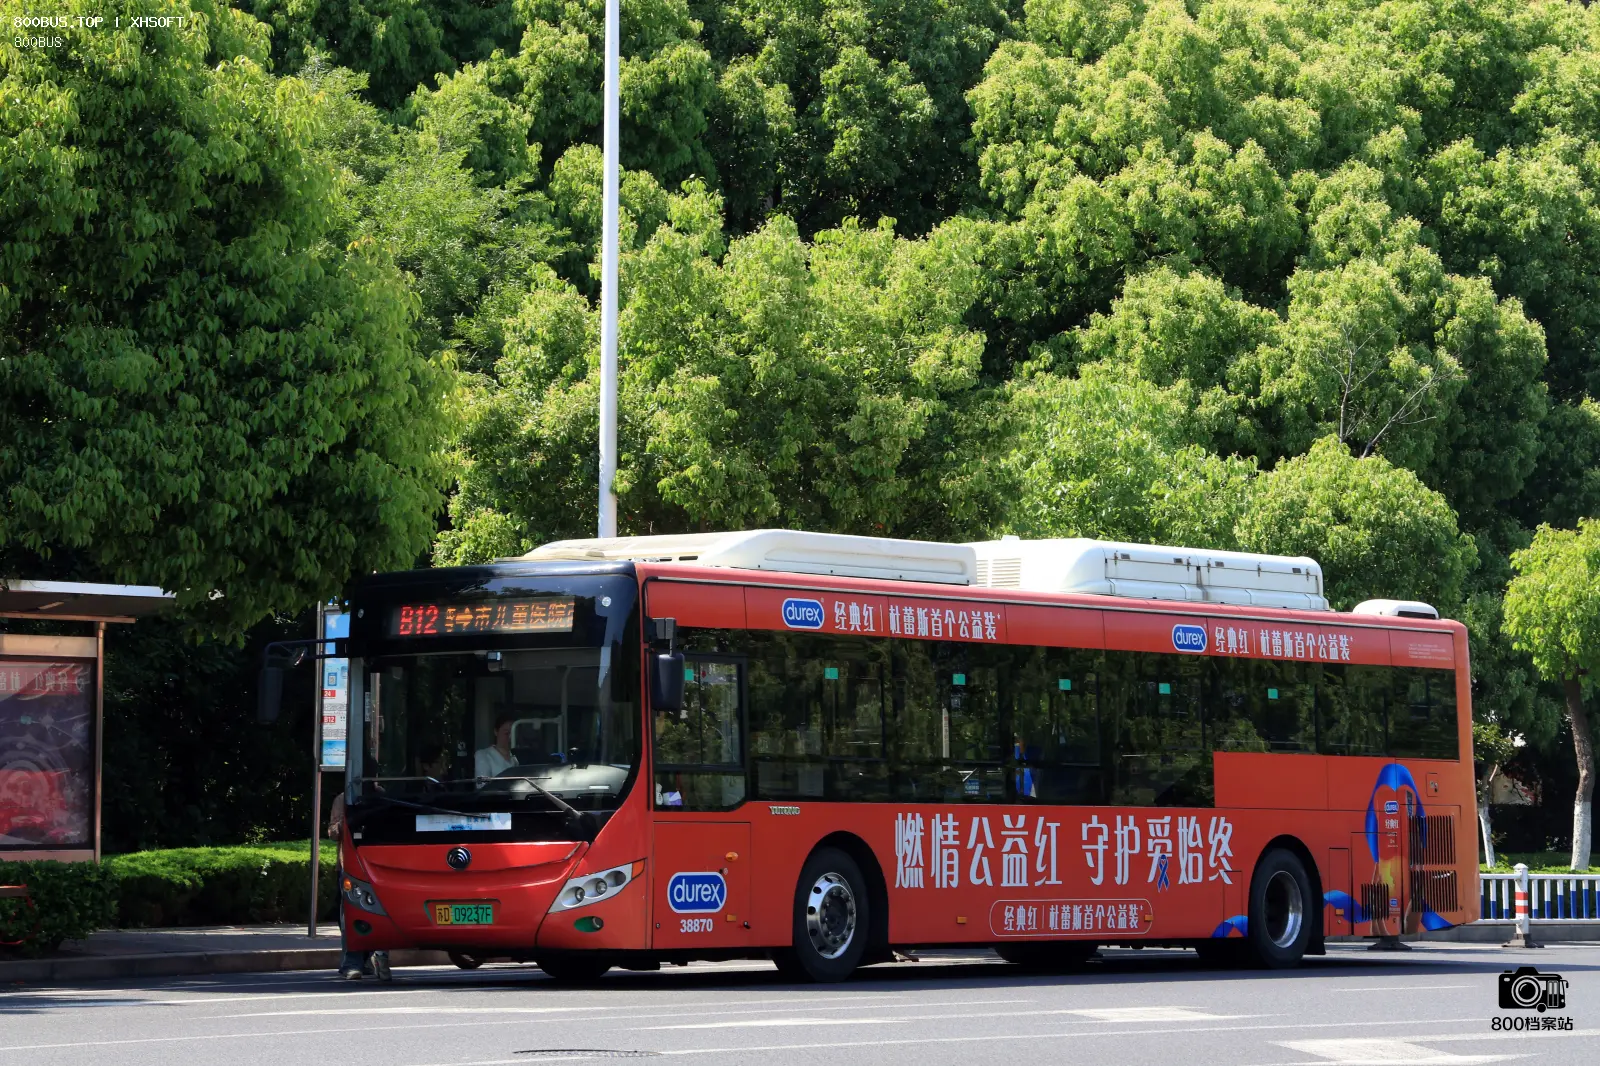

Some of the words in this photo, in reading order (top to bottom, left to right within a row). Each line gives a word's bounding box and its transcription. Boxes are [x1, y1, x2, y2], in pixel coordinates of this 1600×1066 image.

[400, 605, 439, 635] B12
[786, 602, 822, 626] durex
[1176, 628, 1205, 649] durex
[895, 812, 1062, 888] 燃情公益红
[673, 878, 722, 907] durex
[680, 918, 714, 933] 38870
